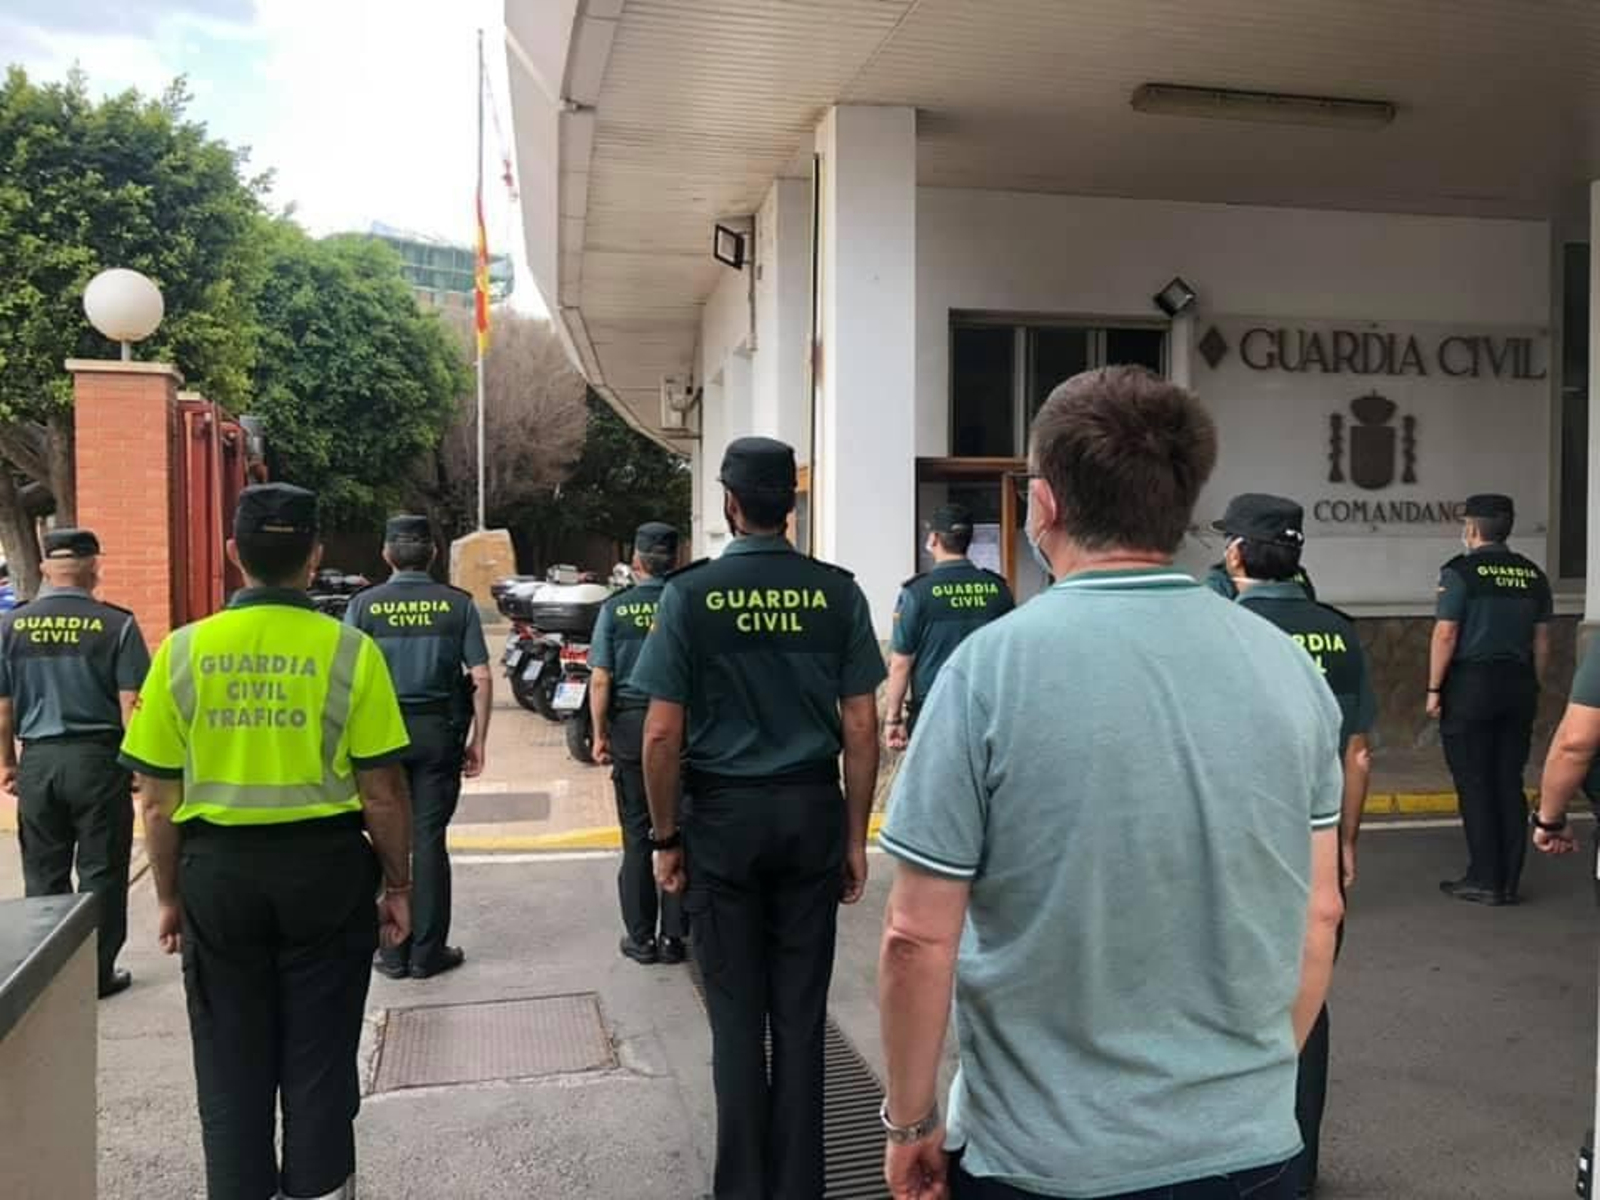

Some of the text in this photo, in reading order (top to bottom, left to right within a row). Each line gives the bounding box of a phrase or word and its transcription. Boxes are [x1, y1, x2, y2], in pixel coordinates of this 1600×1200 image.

[1240, 328, 1547, 380] GUARDIA CIVIL
[1477, 565, 1538, 579] GUARDIA
[932, 583, 999, 598] GUARDIA
[1496, 577, 1528, 589] CIVIL
[706, 589, 827, 610] GUARDIA
[950, 595, 987, 608] CIVIL
[369, 600, 451, 615] GUARDIA
[14, 616, 103, 632] GUARDIA
[388, 612, 433, 627] CIVIL
[737, 611, 803, 633] CIVIL
[30, 629, 81, 644] CIVIL
[200, 655, 317, 677] GUARDIA
[226, 682, 288, 702] CIVIL
[206, 706, 307, 729] TRAFICO
